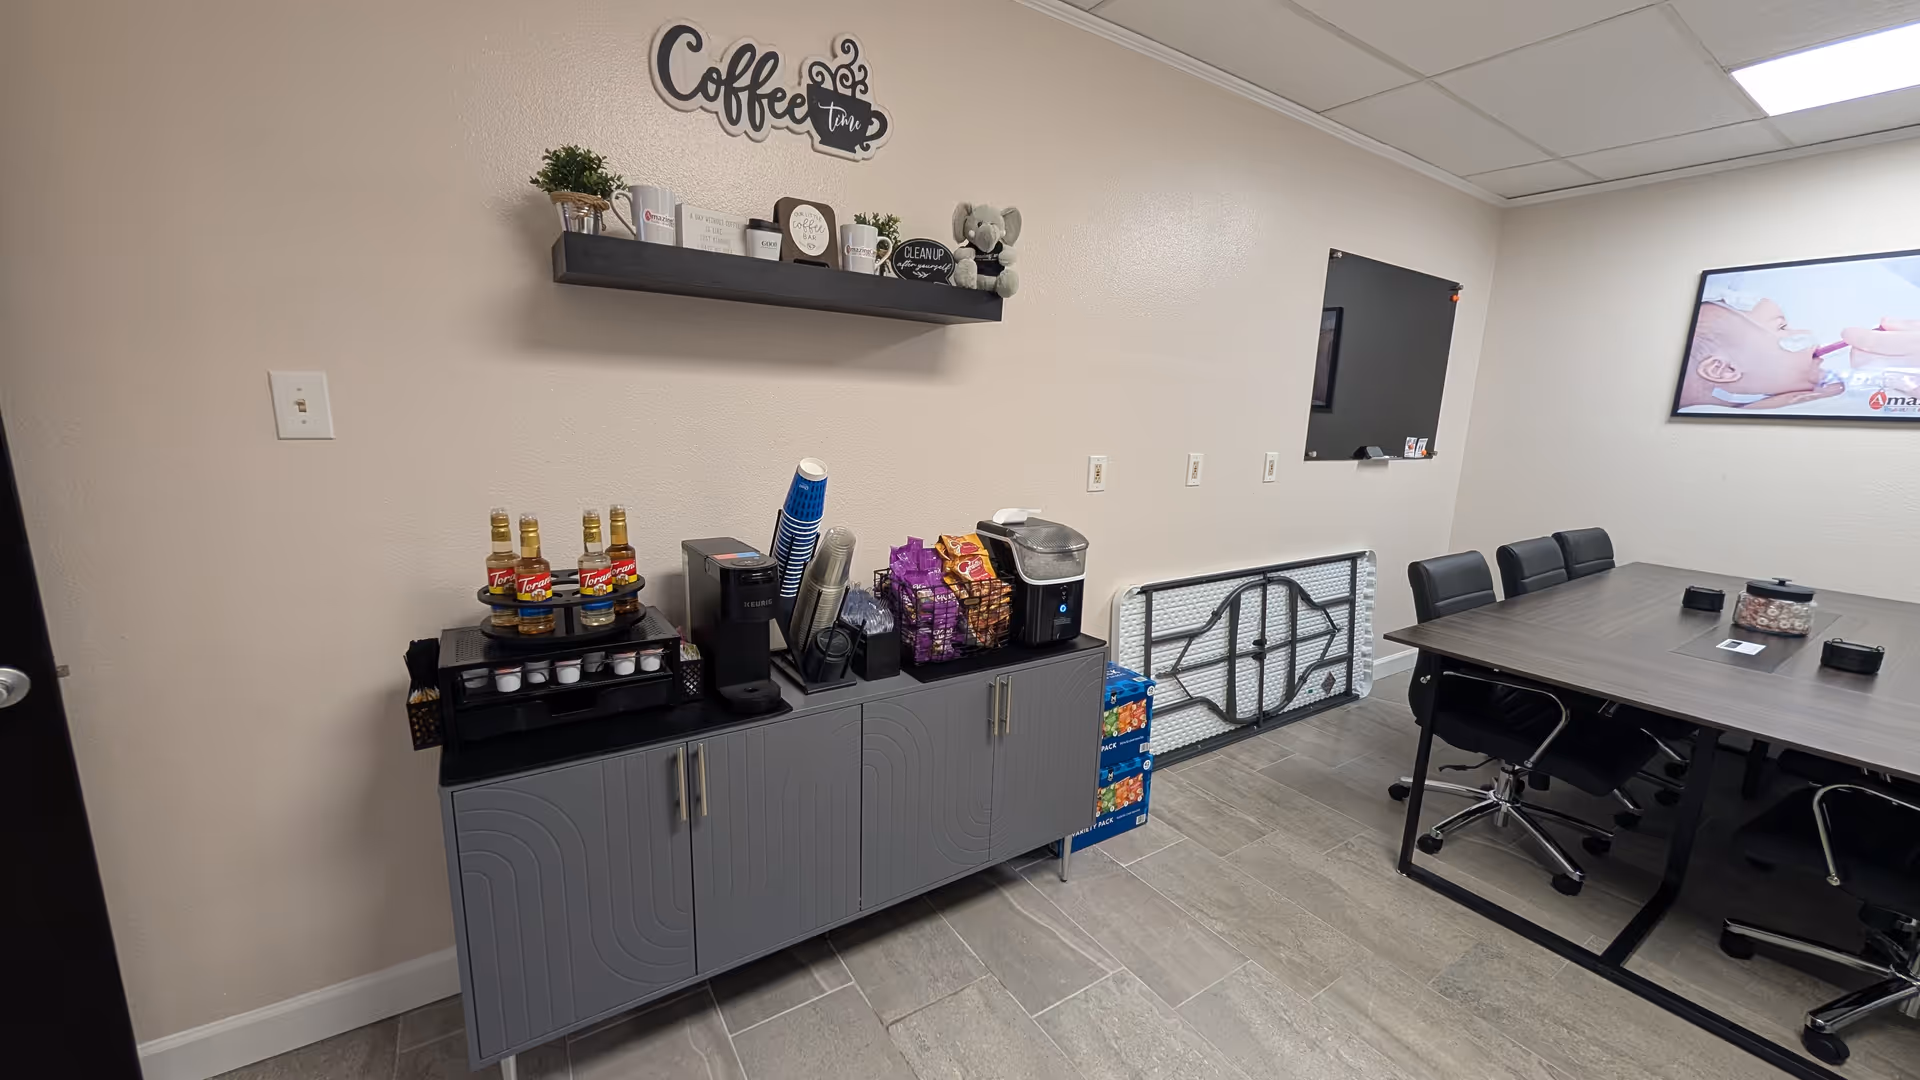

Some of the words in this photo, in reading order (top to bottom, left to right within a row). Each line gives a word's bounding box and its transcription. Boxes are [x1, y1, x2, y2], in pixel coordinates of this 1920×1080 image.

[656, 24, 811, 132] Coffee
[817, 101, 862, 132] time
[803, 233, 817, 241] BAR
[904, 246, 932, 260] CLEAN
[932, 248, 945, 261] UP
[897, 259, 917, 270] after
[915, 263, 952, 273] yourself
[744, 598, 773, 608] KEURIG
[1101, 742, 1117, 752] PACK
[1098, 817, 1114, 828] PACK
